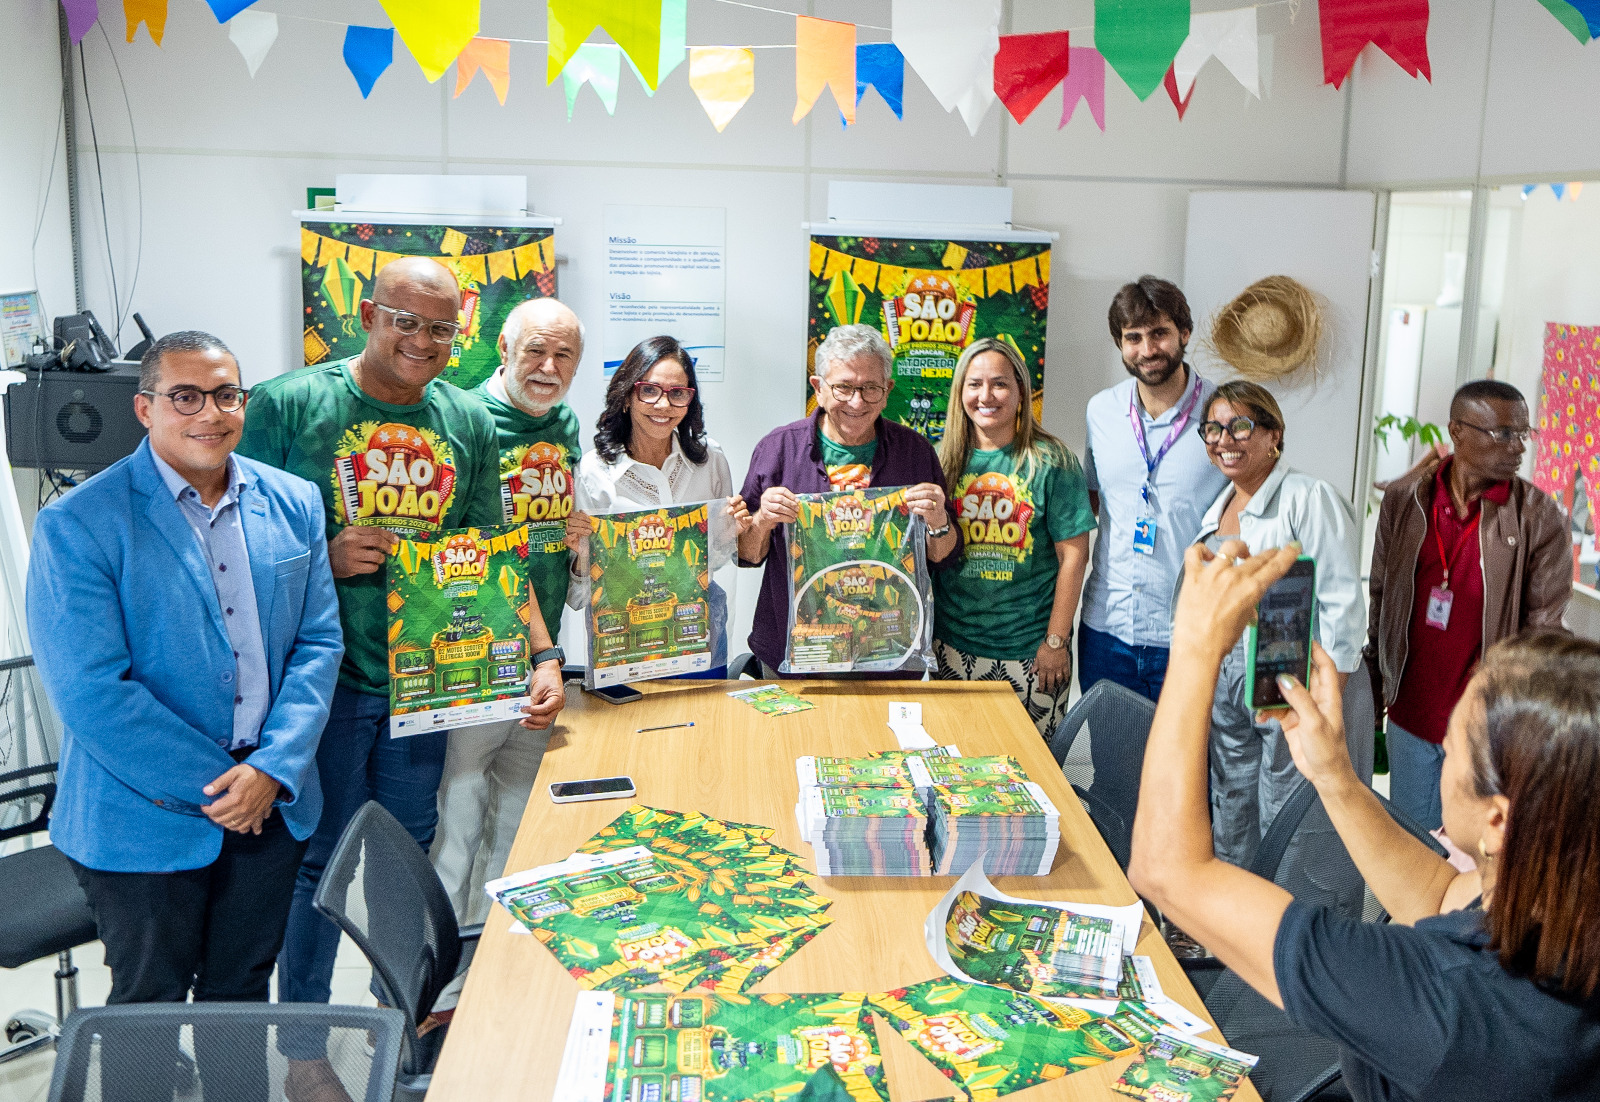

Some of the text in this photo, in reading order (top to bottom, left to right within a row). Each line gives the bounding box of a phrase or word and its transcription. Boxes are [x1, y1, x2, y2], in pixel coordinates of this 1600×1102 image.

[608, 236, 637, 244] Missão
[903, 292, 956, 320] SÃO
[898, 316, 963, 344] JOÃO
[906, 358, 954, 369] TORCIDA
[898, 366, 952, 378] PELO HEXA!
[365, 448, 434, 486] SÃO
[520, 467, 567, 496] SÃO
[356, 480, 440, 518] JOÃO
[512, 494, 573, 524] JOÃO
[834, 507, 863, 520] SÃO
[961, 494, 1014, 520] SÃO
[364, 518, 374, 526] DE
[409, 520, 426, 528] 2026
[832, 519, 868, 534] JOÃO
[638, 525, 665, 540] SÃO
[957, 518, 1021, 544] JOÃO
[636, 537, 669, 552] JOÃO
[444, 548, 477, 564] SÃO
[442, 561, 481, 579] JOÃO
[980, 570, 1012, 581] HEXA!
[843, 576, 867, 586] SÃO
[842, 585, 870, 596] JOÃO
[440, 652, 464, 660] ELÉTRICAS
[446, 646, 463, 654] MOTOS
[463, 644, 484, 652] SCOOTER
[481, 688, 492, 697] 20
[958, 916, 978, 936] SÃO
[970, 921, 992, 948] JOÃO
